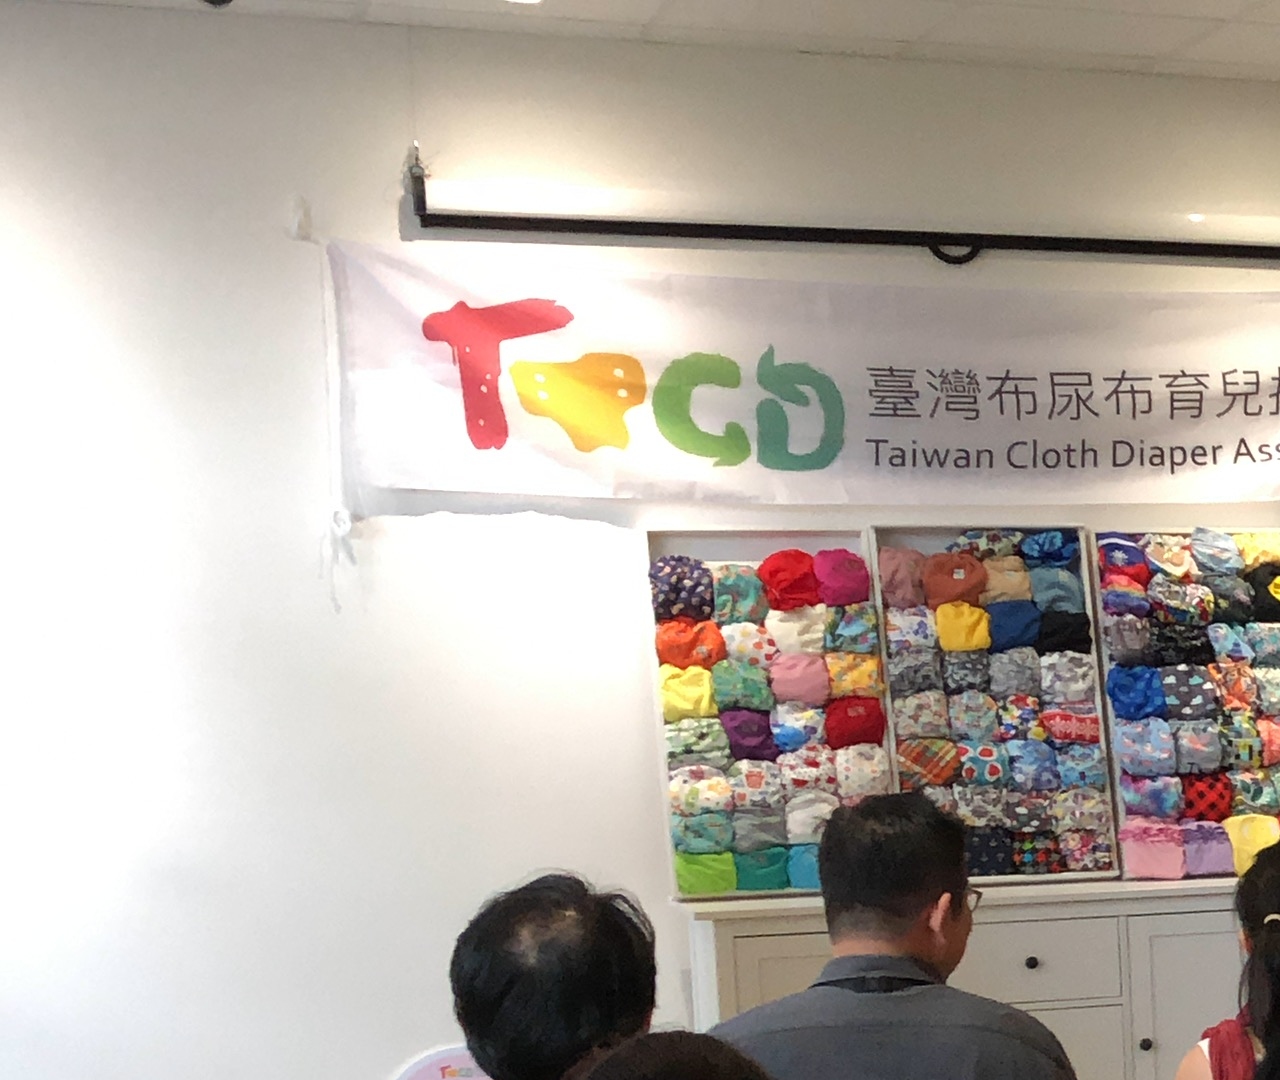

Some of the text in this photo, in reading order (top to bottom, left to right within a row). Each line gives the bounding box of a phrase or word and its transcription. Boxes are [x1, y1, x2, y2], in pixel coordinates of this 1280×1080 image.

[866, 439, 994, 469] Taiwan
[1006, 437, 1098, 470] Cloth
[1111, 438, 1224, 476] Diaper
